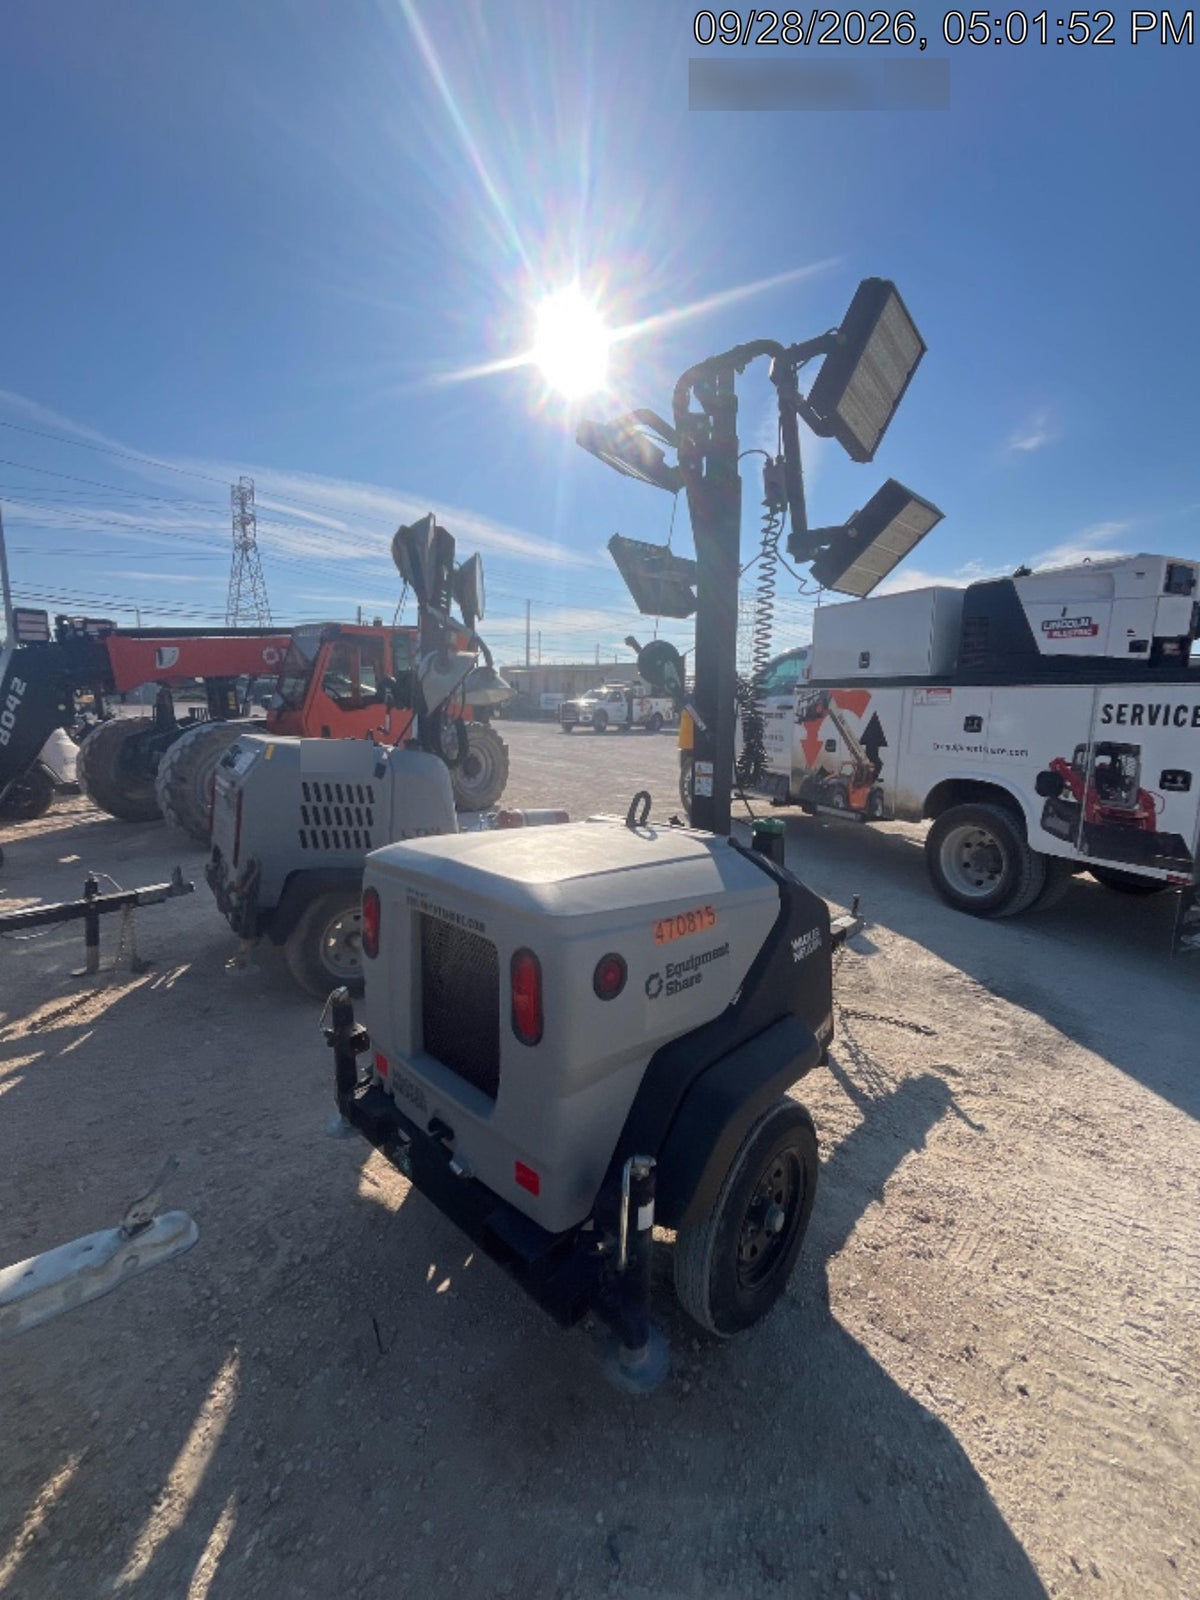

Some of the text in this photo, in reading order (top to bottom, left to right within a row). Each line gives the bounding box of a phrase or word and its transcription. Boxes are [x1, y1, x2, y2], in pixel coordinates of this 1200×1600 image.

[0, 677, 27, 745] 8042
[1101, 703, 1200, 727] SERVICE
[654, 905, 717, 942] 470815
[665, 942, 730, 979] Equipment
[665, 972, 703, 996] Share
